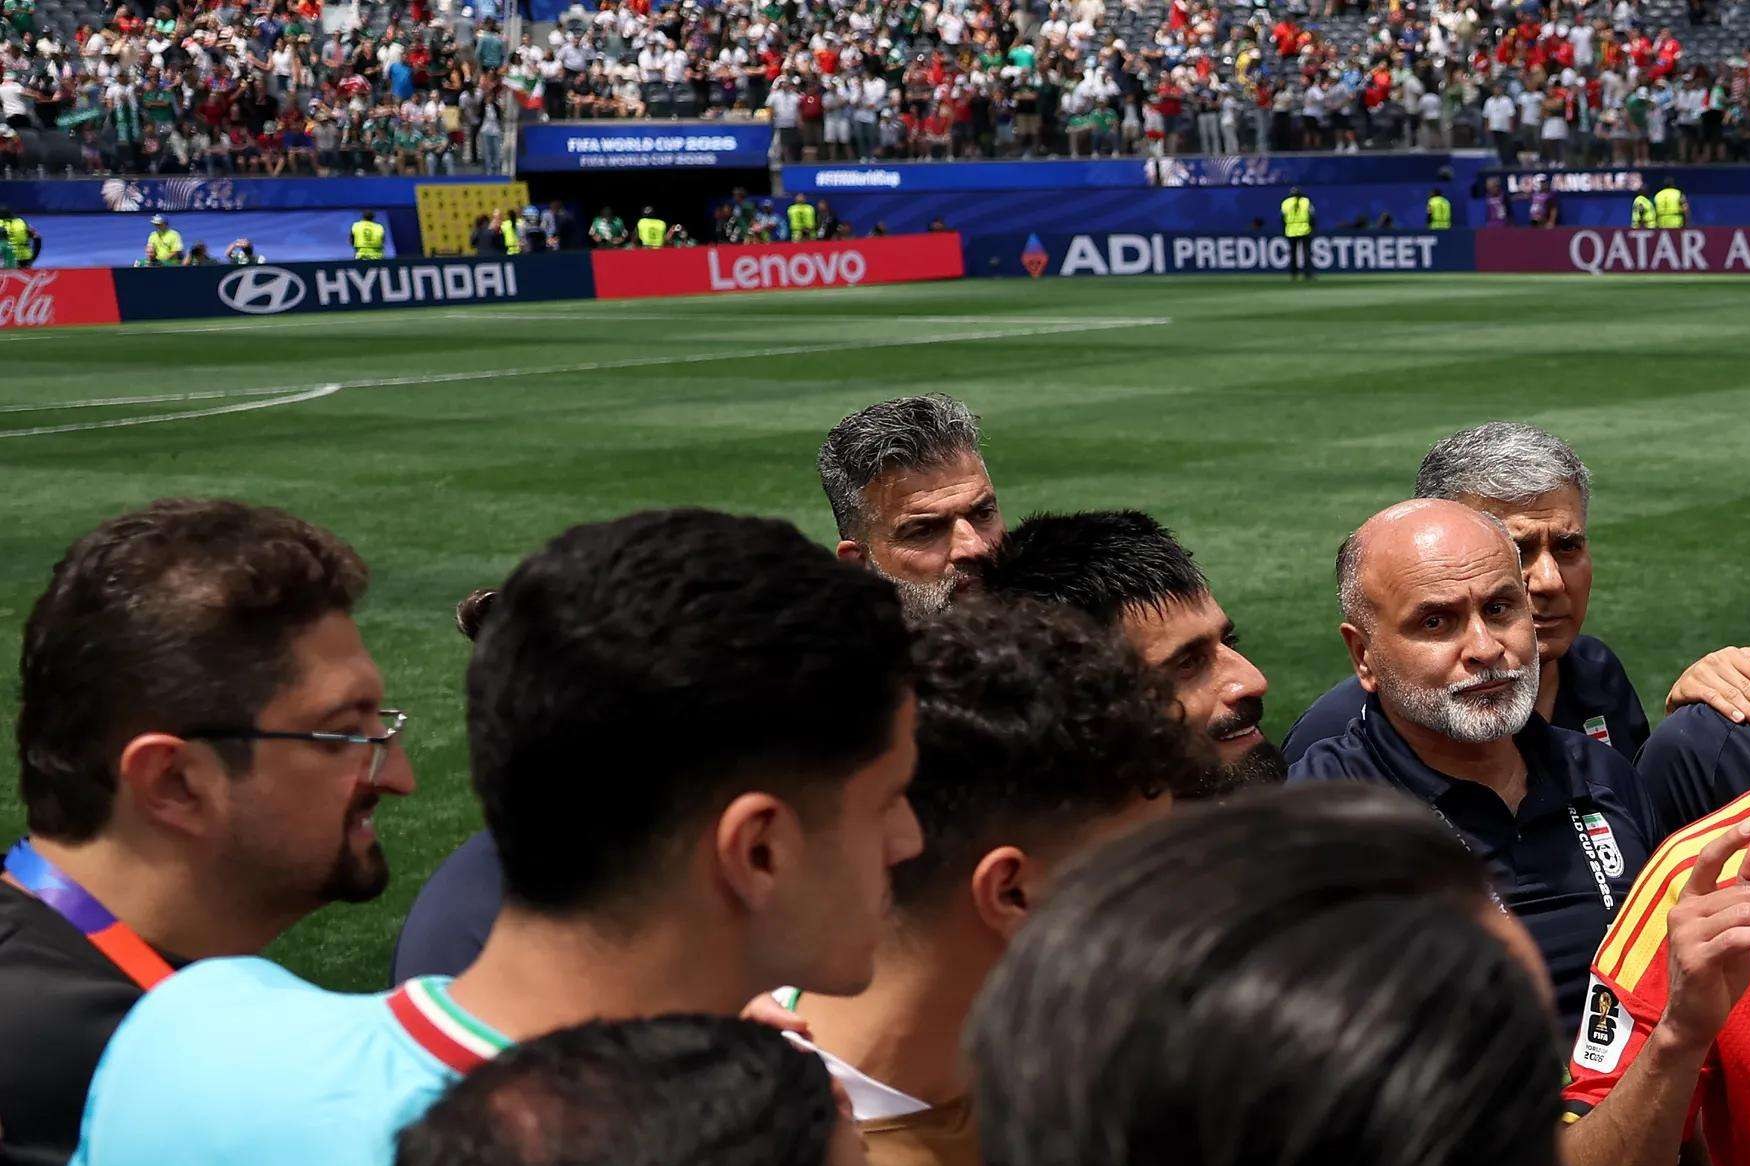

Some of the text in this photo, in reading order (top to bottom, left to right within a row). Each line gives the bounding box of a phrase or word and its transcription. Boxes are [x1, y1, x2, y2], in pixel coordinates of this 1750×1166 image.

[707, 247, 866, 291] Lenovo
[1060, 233, 1163, 276] ADI
[1569, 230, 1706, 275] QATAR
[0, 270, 58, 327] ola
[316, 261, 518, 305] HYUNDAI
[1568, 806, 1614, 910] RLD CUP 2026
[1593, 1031, 1609, 1042] FIFA
